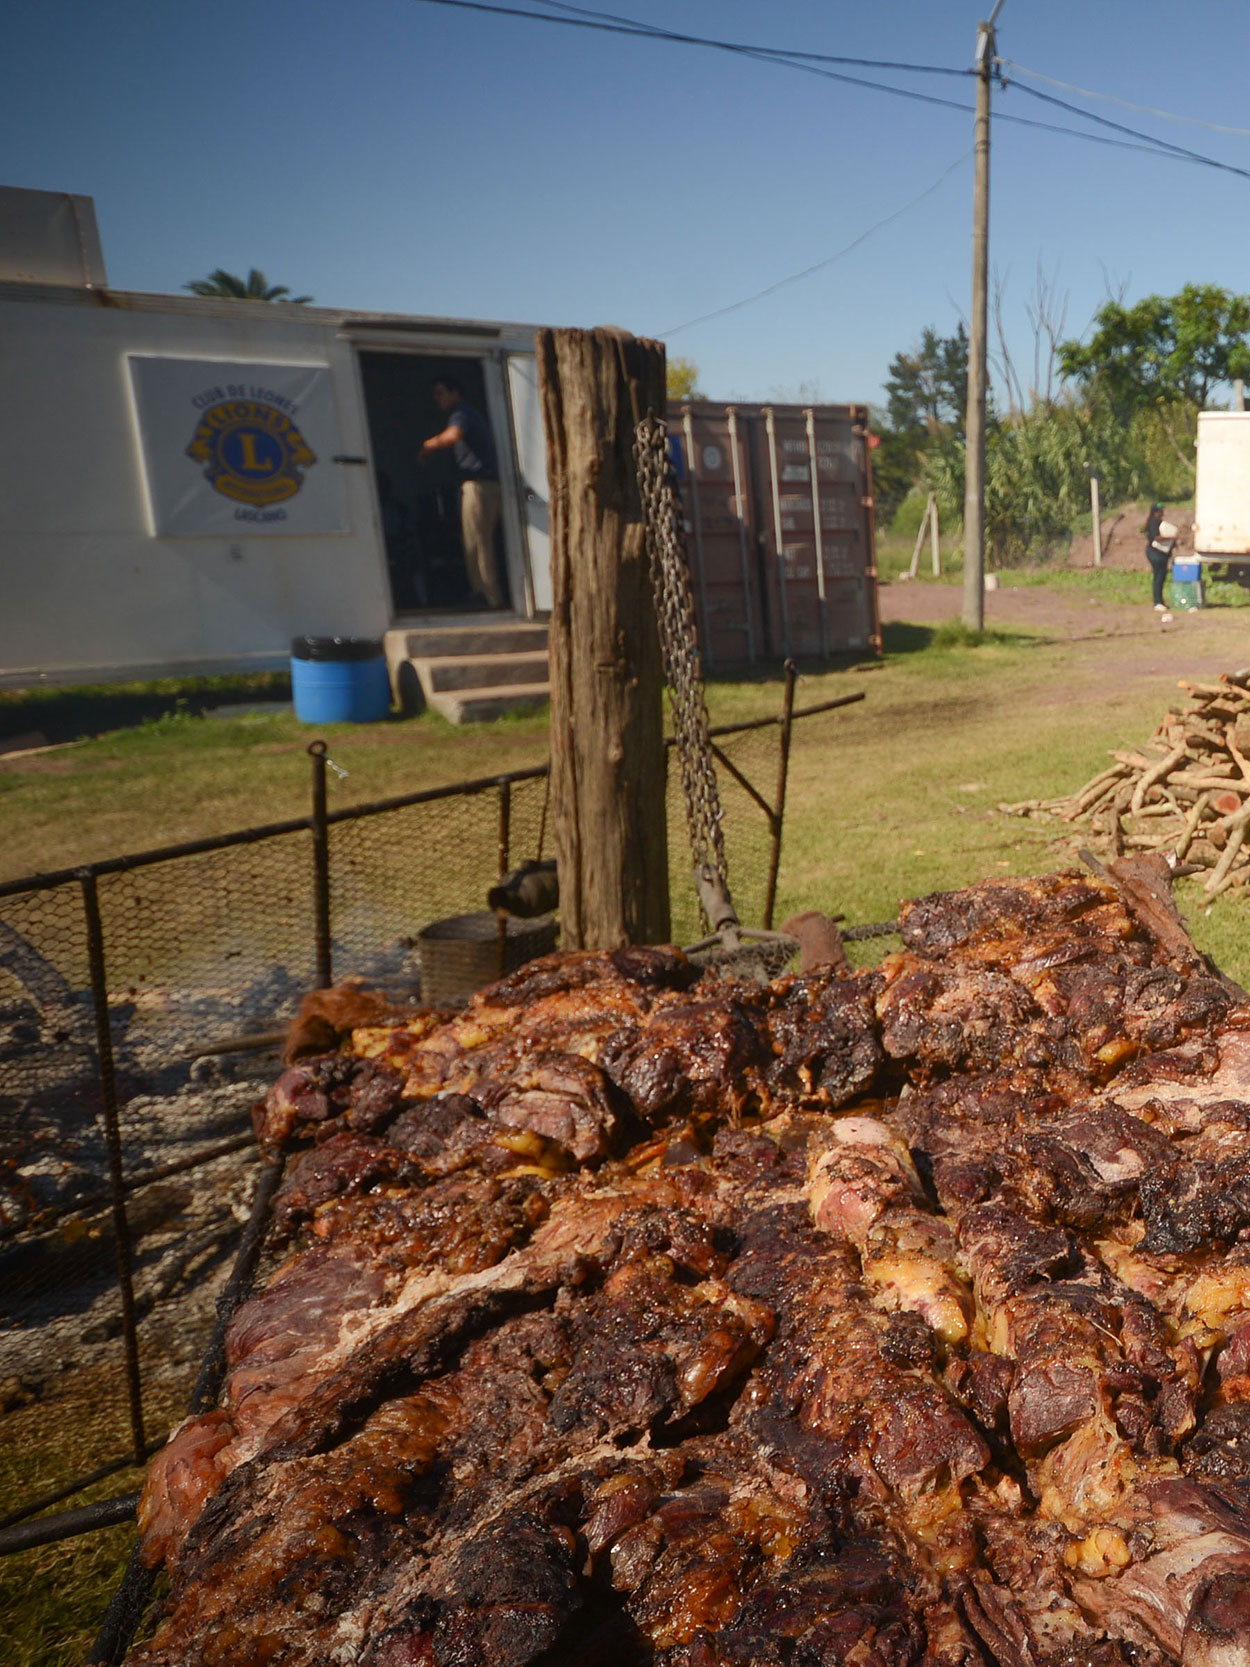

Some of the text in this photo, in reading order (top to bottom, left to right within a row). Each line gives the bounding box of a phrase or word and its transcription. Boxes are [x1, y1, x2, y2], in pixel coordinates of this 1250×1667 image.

[191, 386, 225, 410] CLUB
[226, 384, 246, 397] DE
[211, 403, 284, 429] LIONS
[237, 433, 273, 471] L
